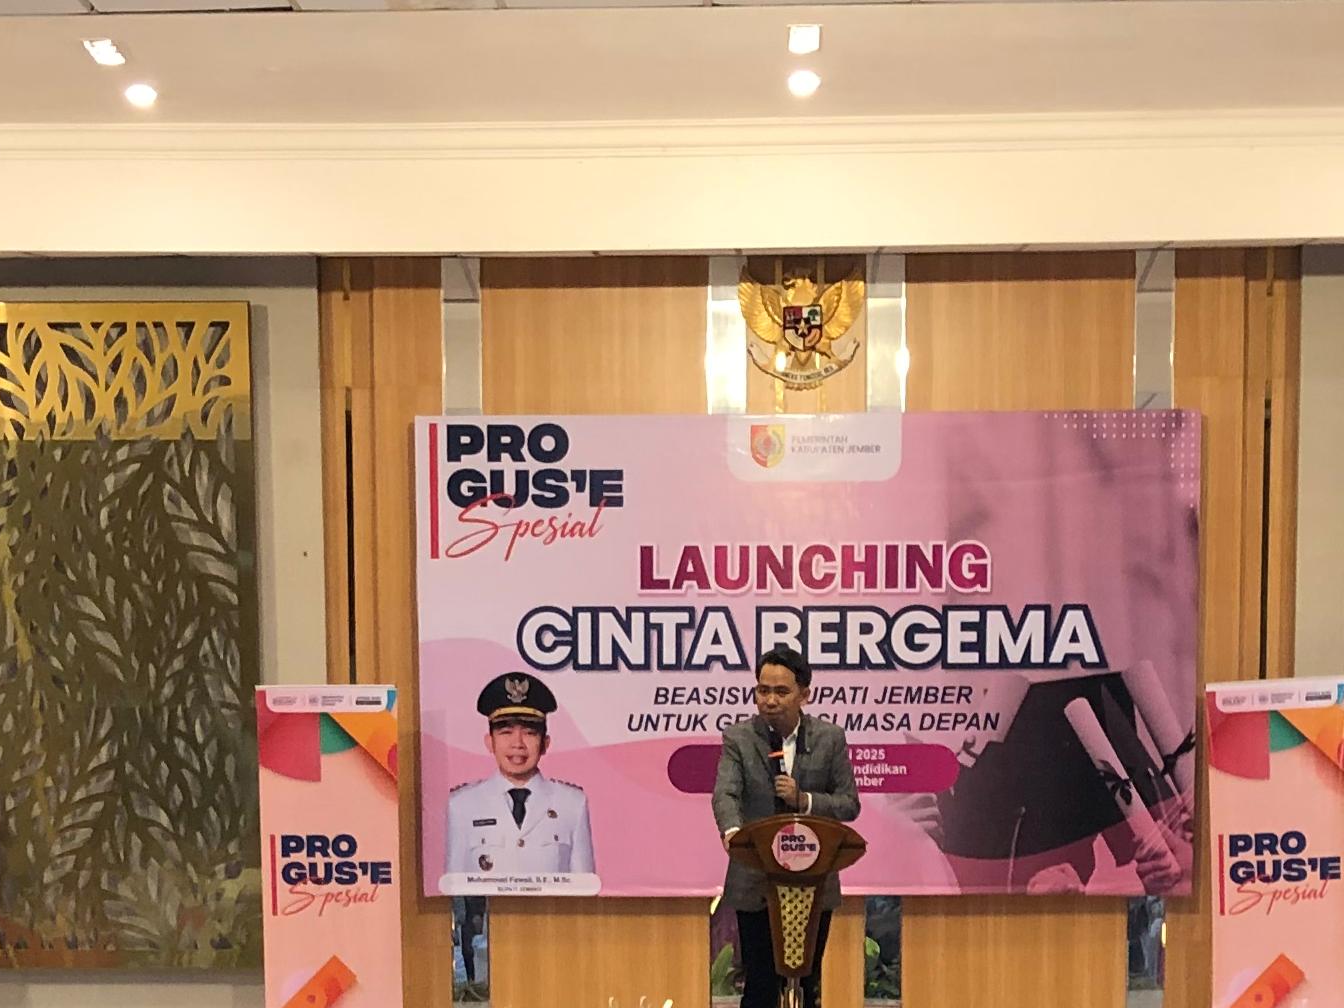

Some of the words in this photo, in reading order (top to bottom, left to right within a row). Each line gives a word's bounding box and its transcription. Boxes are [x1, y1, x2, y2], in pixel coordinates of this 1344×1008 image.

[446, 423, 570, 464] PRO
[446, 468, 624, 509] GUS'E
[445, 493, 606, 562] Spesial
[638, 543, 992, 592] LAUNCHING
[517, 605, 751, 671] CINTA
[755, 604, 1109, 671] BERGEMA
[654, 686, 758, 705] BEASISW
[808, 686, 868, 705] UPATI
[874, 686, 974, 705] JEMBER
[627, 713, 709, 732] UNTUK
[844, 712, 912, 732] MASA
[919, 711, 1001, 732] DEPAN
[856, 748, 886, 761] 2025
[853, 763, 907, 775] ndidikan
[855, 775, 885, 787] mber
[280, 834, 358, 859] PRO
[781, 834, 806, 843] PRO
[1228, 830, 1307, 858] PRO
[280, 860, 393, 886] GUS'E
[1228, 857, 1342, 885] GUS'E
[282, 878, 380, 917] Spesial
[1229, 876, 1329, 916] Spesial
